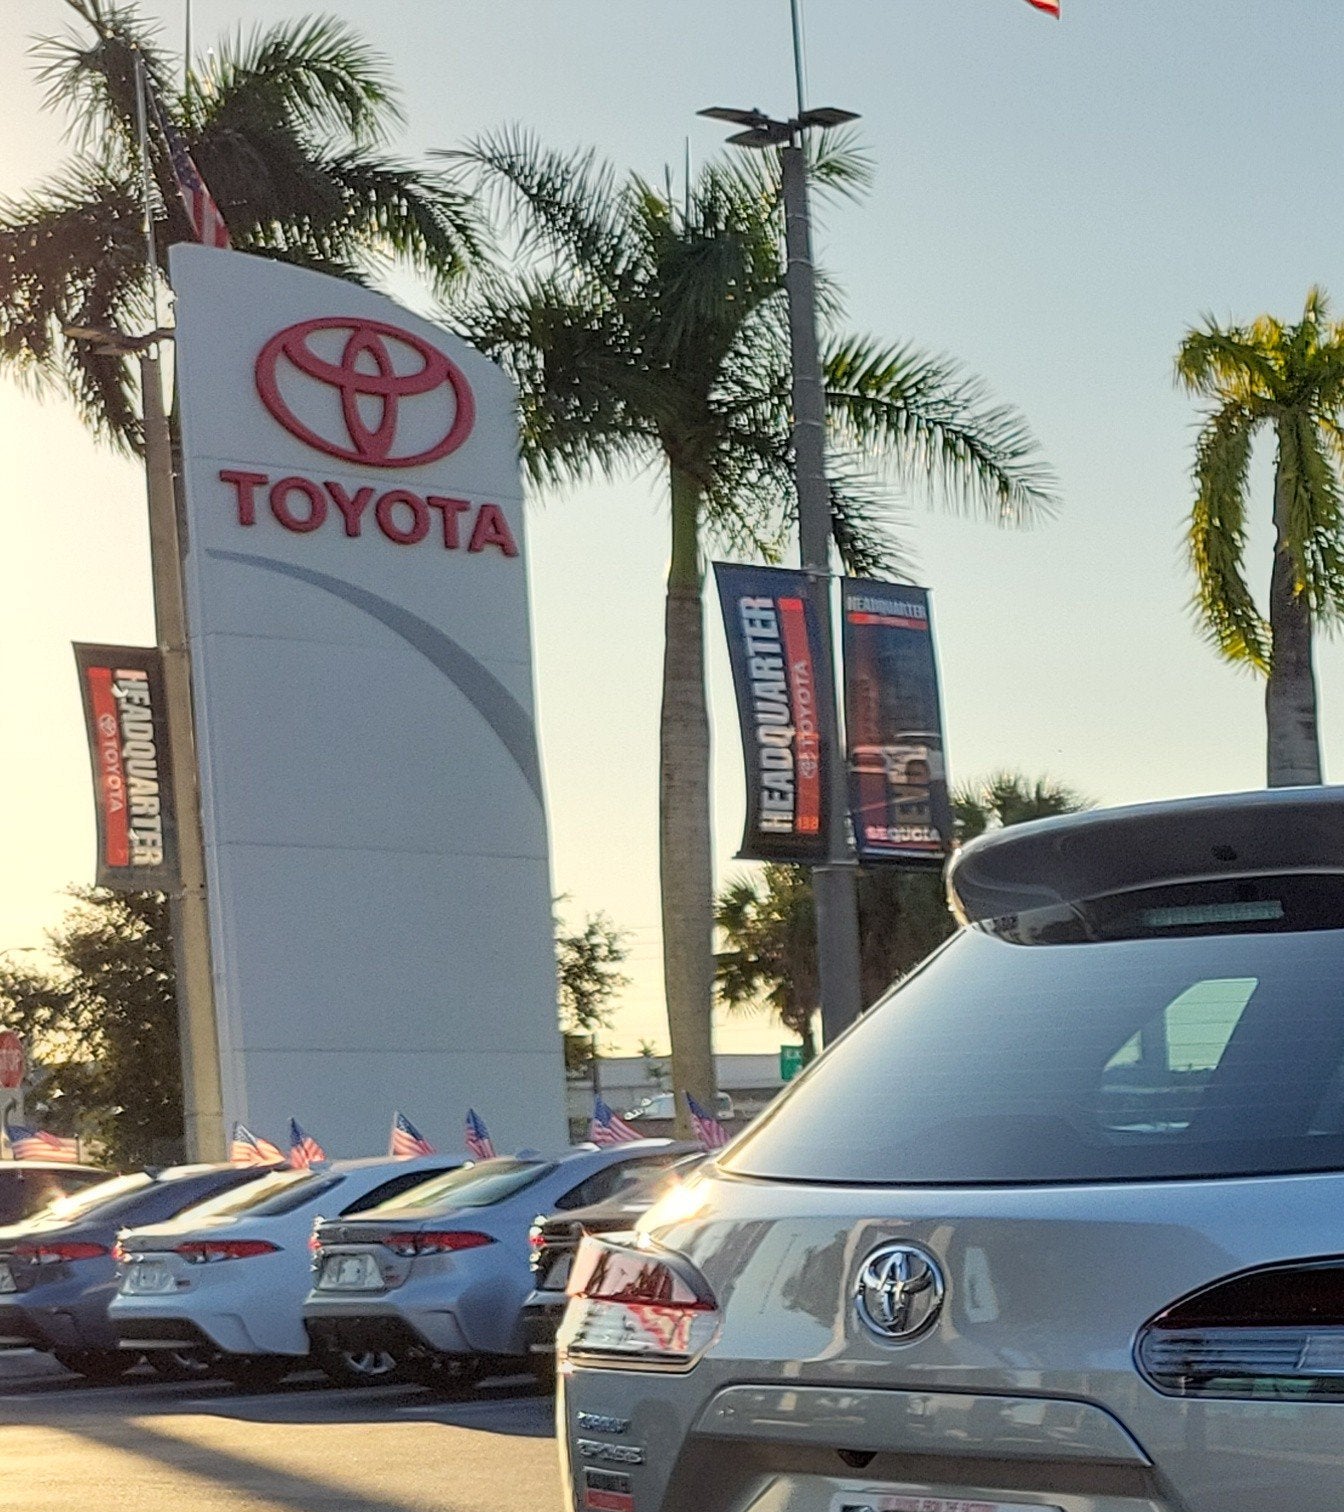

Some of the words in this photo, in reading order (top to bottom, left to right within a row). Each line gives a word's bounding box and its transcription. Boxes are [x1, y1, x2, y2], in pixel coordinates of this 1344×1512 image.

[218, 470, 518, 557] TOYOTA
[740, 597, 794, 834] HEADQUARTER
[793, 660, 816, 749] TOYOTA
[103, 737, 122, 813] TOYOTA
[114, 668, 163, 866] HEADQUARTER
